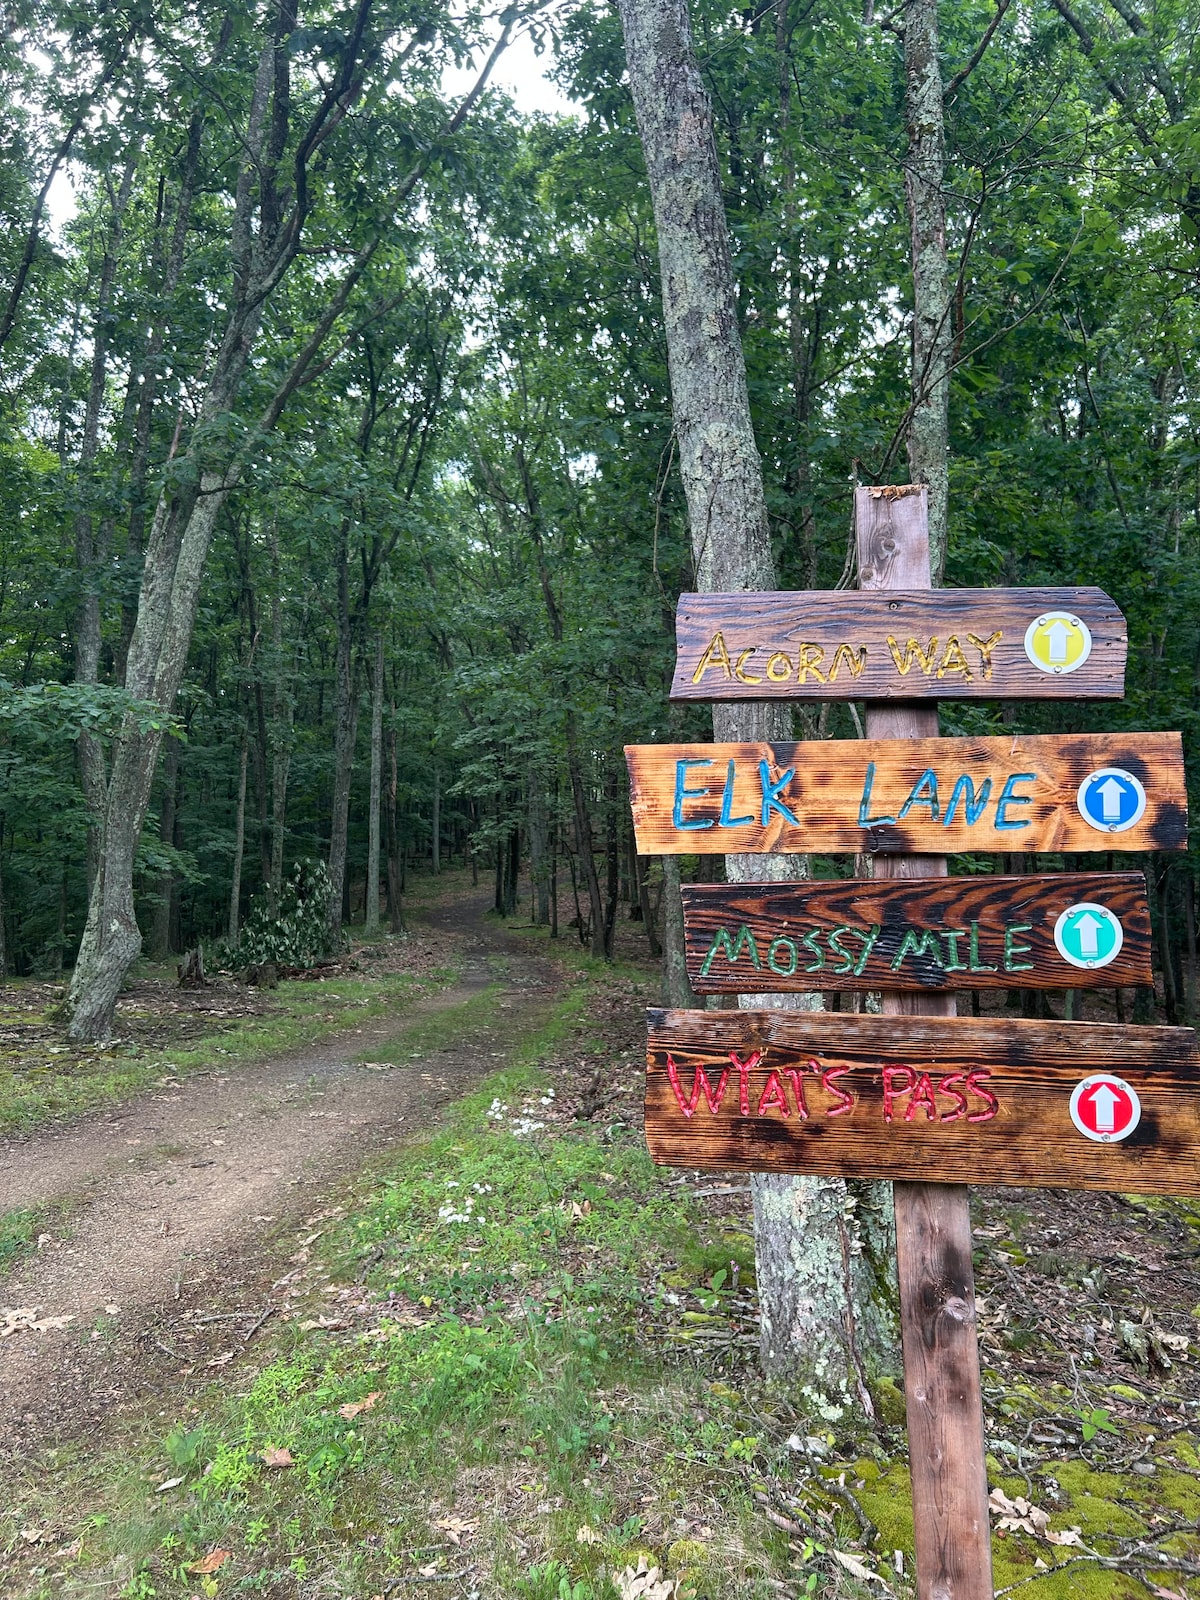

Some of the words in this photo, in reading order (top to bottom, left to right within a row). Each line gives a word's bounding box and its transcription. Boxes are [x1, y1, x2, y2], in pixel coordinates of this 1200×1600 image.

[692, 631, 867, 684] ACORN
[886, 630, 1003, 682] WAY
[672, 758, 800, 830] ELK
[857, 762, 1037, 830] LANE
[700, 924, 881, 976] MOSSY
[890, 920, 1034, 972] MILE
[666, 1050, 854, 1120] WYAT'S
[882, 1064, 999, 1123] PASS
